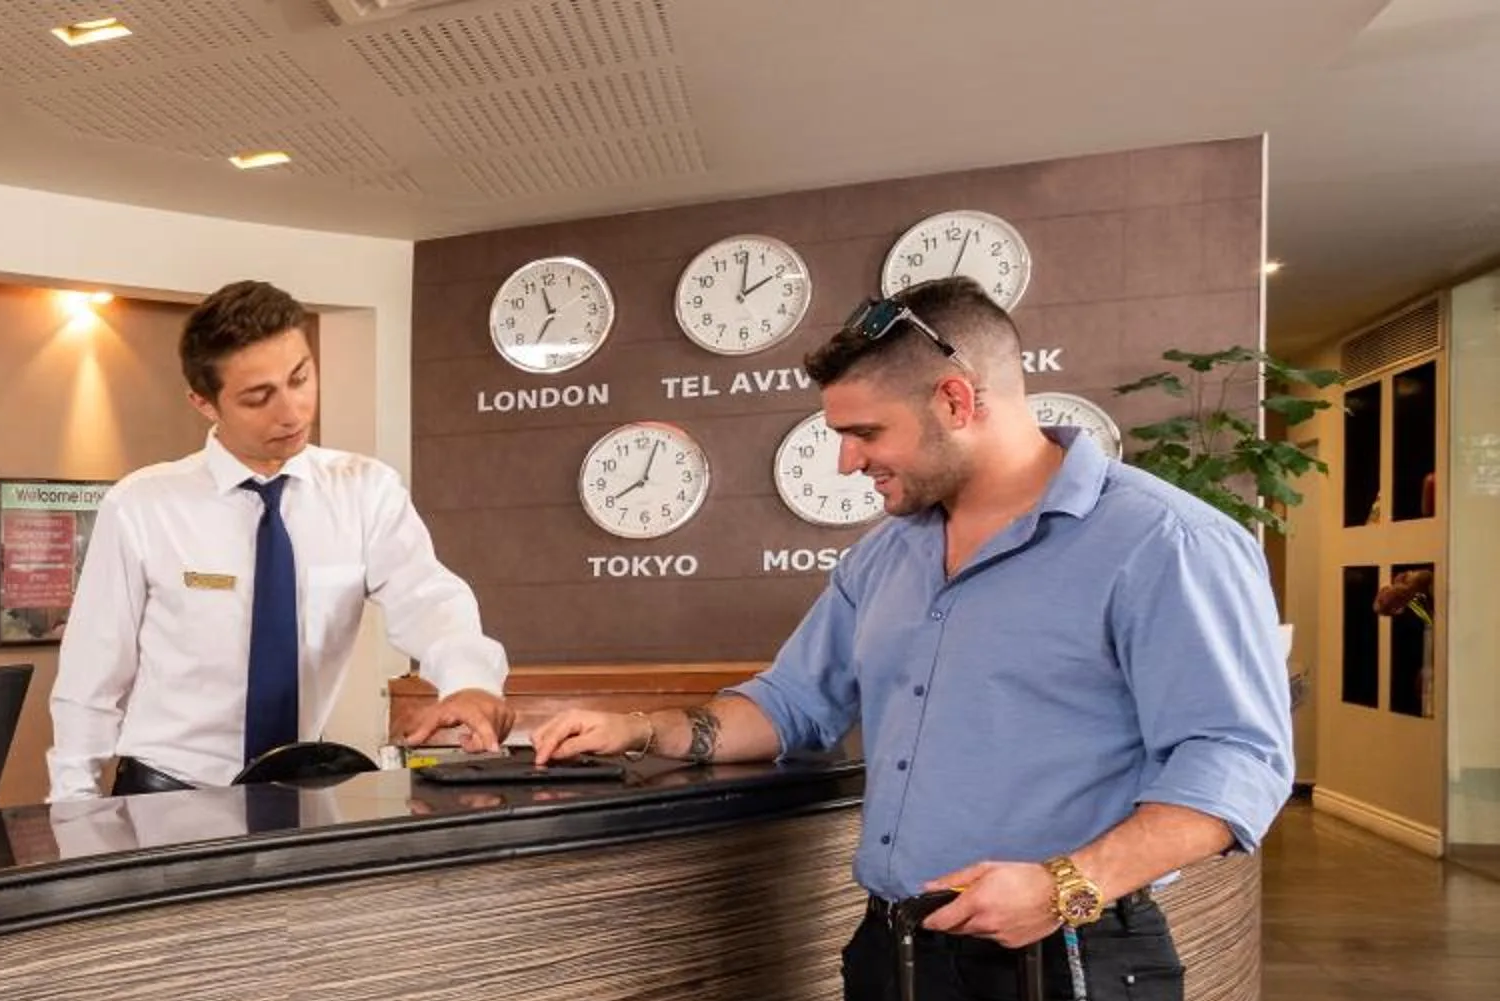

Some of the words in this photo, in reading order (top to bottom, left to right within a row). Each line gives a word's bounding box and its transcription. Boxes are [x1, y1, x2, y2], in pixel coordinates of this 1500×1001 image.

[945, 227, 961, 241] 12
[973, 231, 980, 243] 1
[923, 237, 937, 251] 11
[991, 242, 1002, 256] 2
[760, 253, 765, 265] 1
[907, 253, 923, 266] 10
[713, 260, 727, 272] 11
[775, 265, 786, 278] 2
[999, 261, 1010, 274] 3
[542, 273, 555, 286] 12
[566, 275, 571, 287] 1
[700, 276, 714, 288] 10
[901, 274, 911, 287] 9
[524, 282, 536, 294] 11
[783, 283, 793, 297] 3
[993, 282, 1003, 294] 4
[511, 298, 525, 309] 10
[692, 295, 703, 308] 9
[777, 303, 787, 315] 4
[506, 317, 515, 329] 9
[702, 313, 712, 326] 8
[761, 320, 771, 332] 5
[717, 324, 727, 337] 7
[739, 327, 749, 340] 6
[515, 333, 525, 345] 8
[1021, 348, 1063, 373] RK
[661, 375, 720, 399] TEL
[729, 367, 812, 394] AVIV
[477, 383, 609, 412] LONDON
[813, 429, 827, 442] 11
[634, 438, 650, 450] 12
[616, 445, 629, 457] 11
[799, 445, 815, 458] 10
[602, 459, 617, 472] 10
[675, 453, 685, 465] 2
[682, 471, 692, 483] 3
[792, 465, 803, 478] 9
[596, 478, 606, 490] 9
[803, 483, 813, 497] 8
[605, 496, 615, 508] 8
[677, 490, 686, 502] 4
[818, 495, 828, 509] 7
[864, 491, 875, 505] 5
[661, 504, 671, 517] 5
[840, 498, 852, 512] 6
[620, 507, 629, 519] 7
[639, 511, 650, 523] 6
[587, 554, 698, 577] TOKYO
[762, 548, 852, 572] MOS
